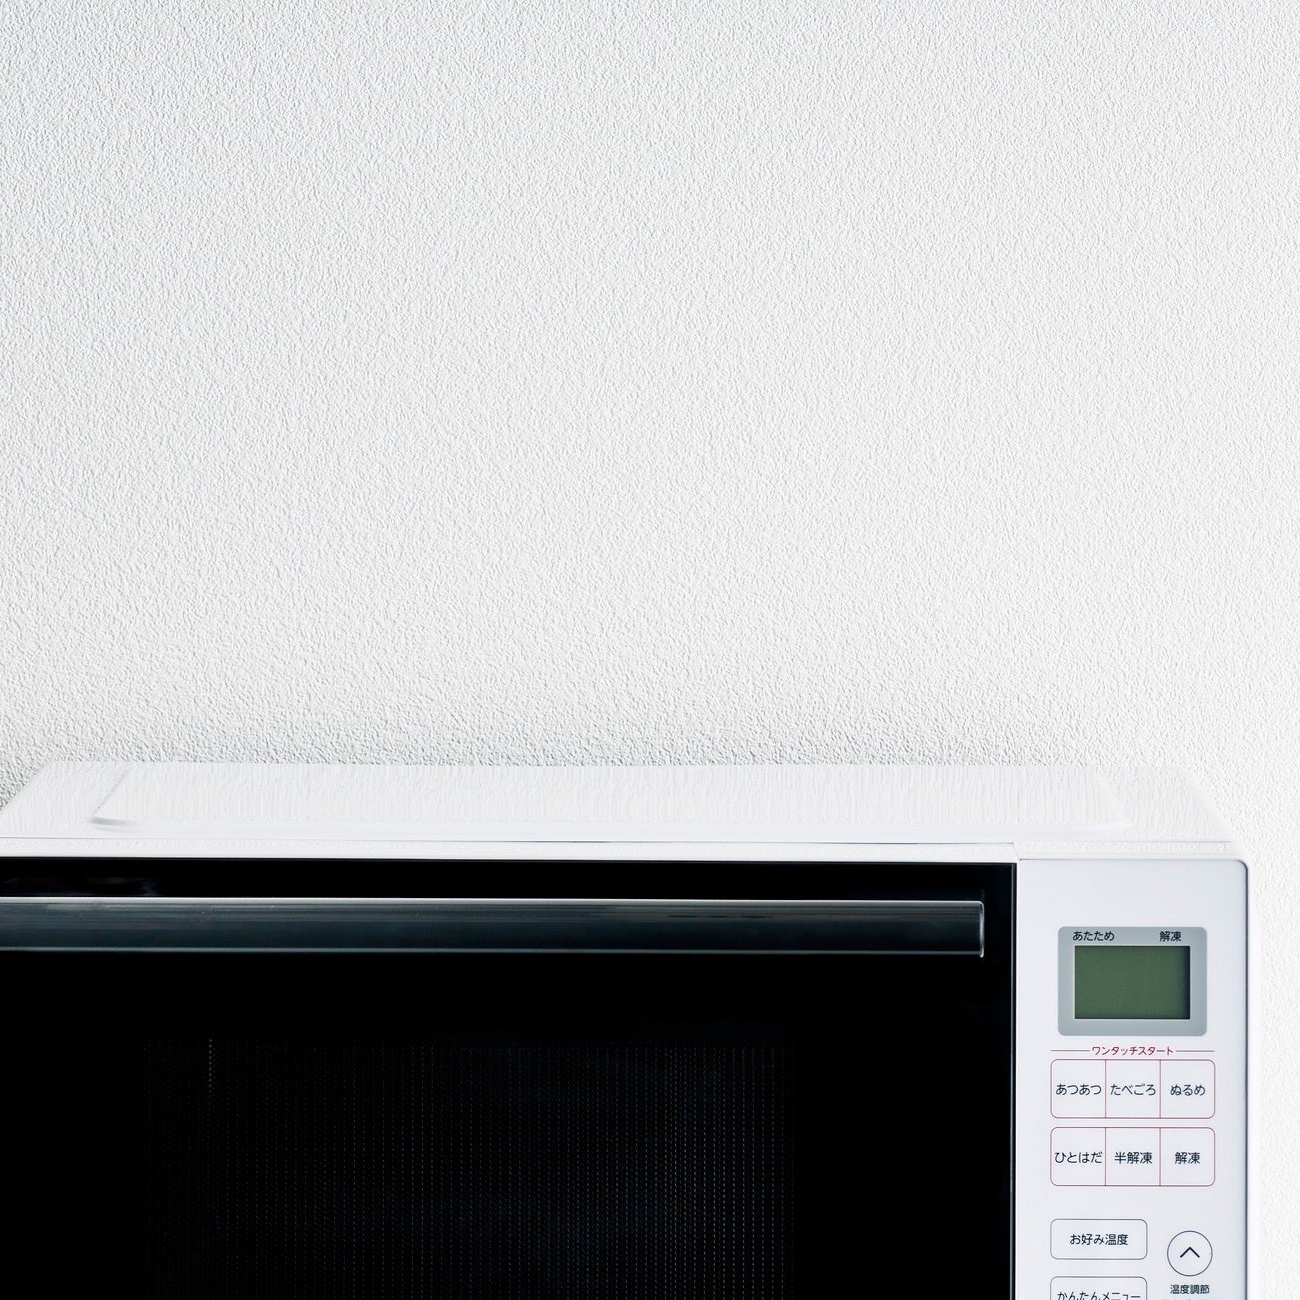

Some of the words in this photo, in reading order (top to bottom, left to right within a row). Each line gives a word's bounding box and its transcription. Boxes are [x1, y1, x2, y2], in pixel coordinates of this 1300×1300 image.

[1072, 930, 1115, 942] あたため
[1159, 930, 1182, 942] 解凍
[1091, 1046, 1174, 1056] ワンタッチスタート
[1055, 1083, 1102, 1096] あつあつ
[1110, 1083, 1157, 1096] たべごろ
[1170, 1083, 1206, 1097] ぬるめ
[1054, 1151, 1103, 1164] ひとはだ
[1114, 1151, 1153, 1165] 半解凍
[1174, 1151, 1201, 1165] 解凍
[1069, 1233, 1129, 1246] お好み温度
[1169, 1284, 1210, 1295] 温度調節
